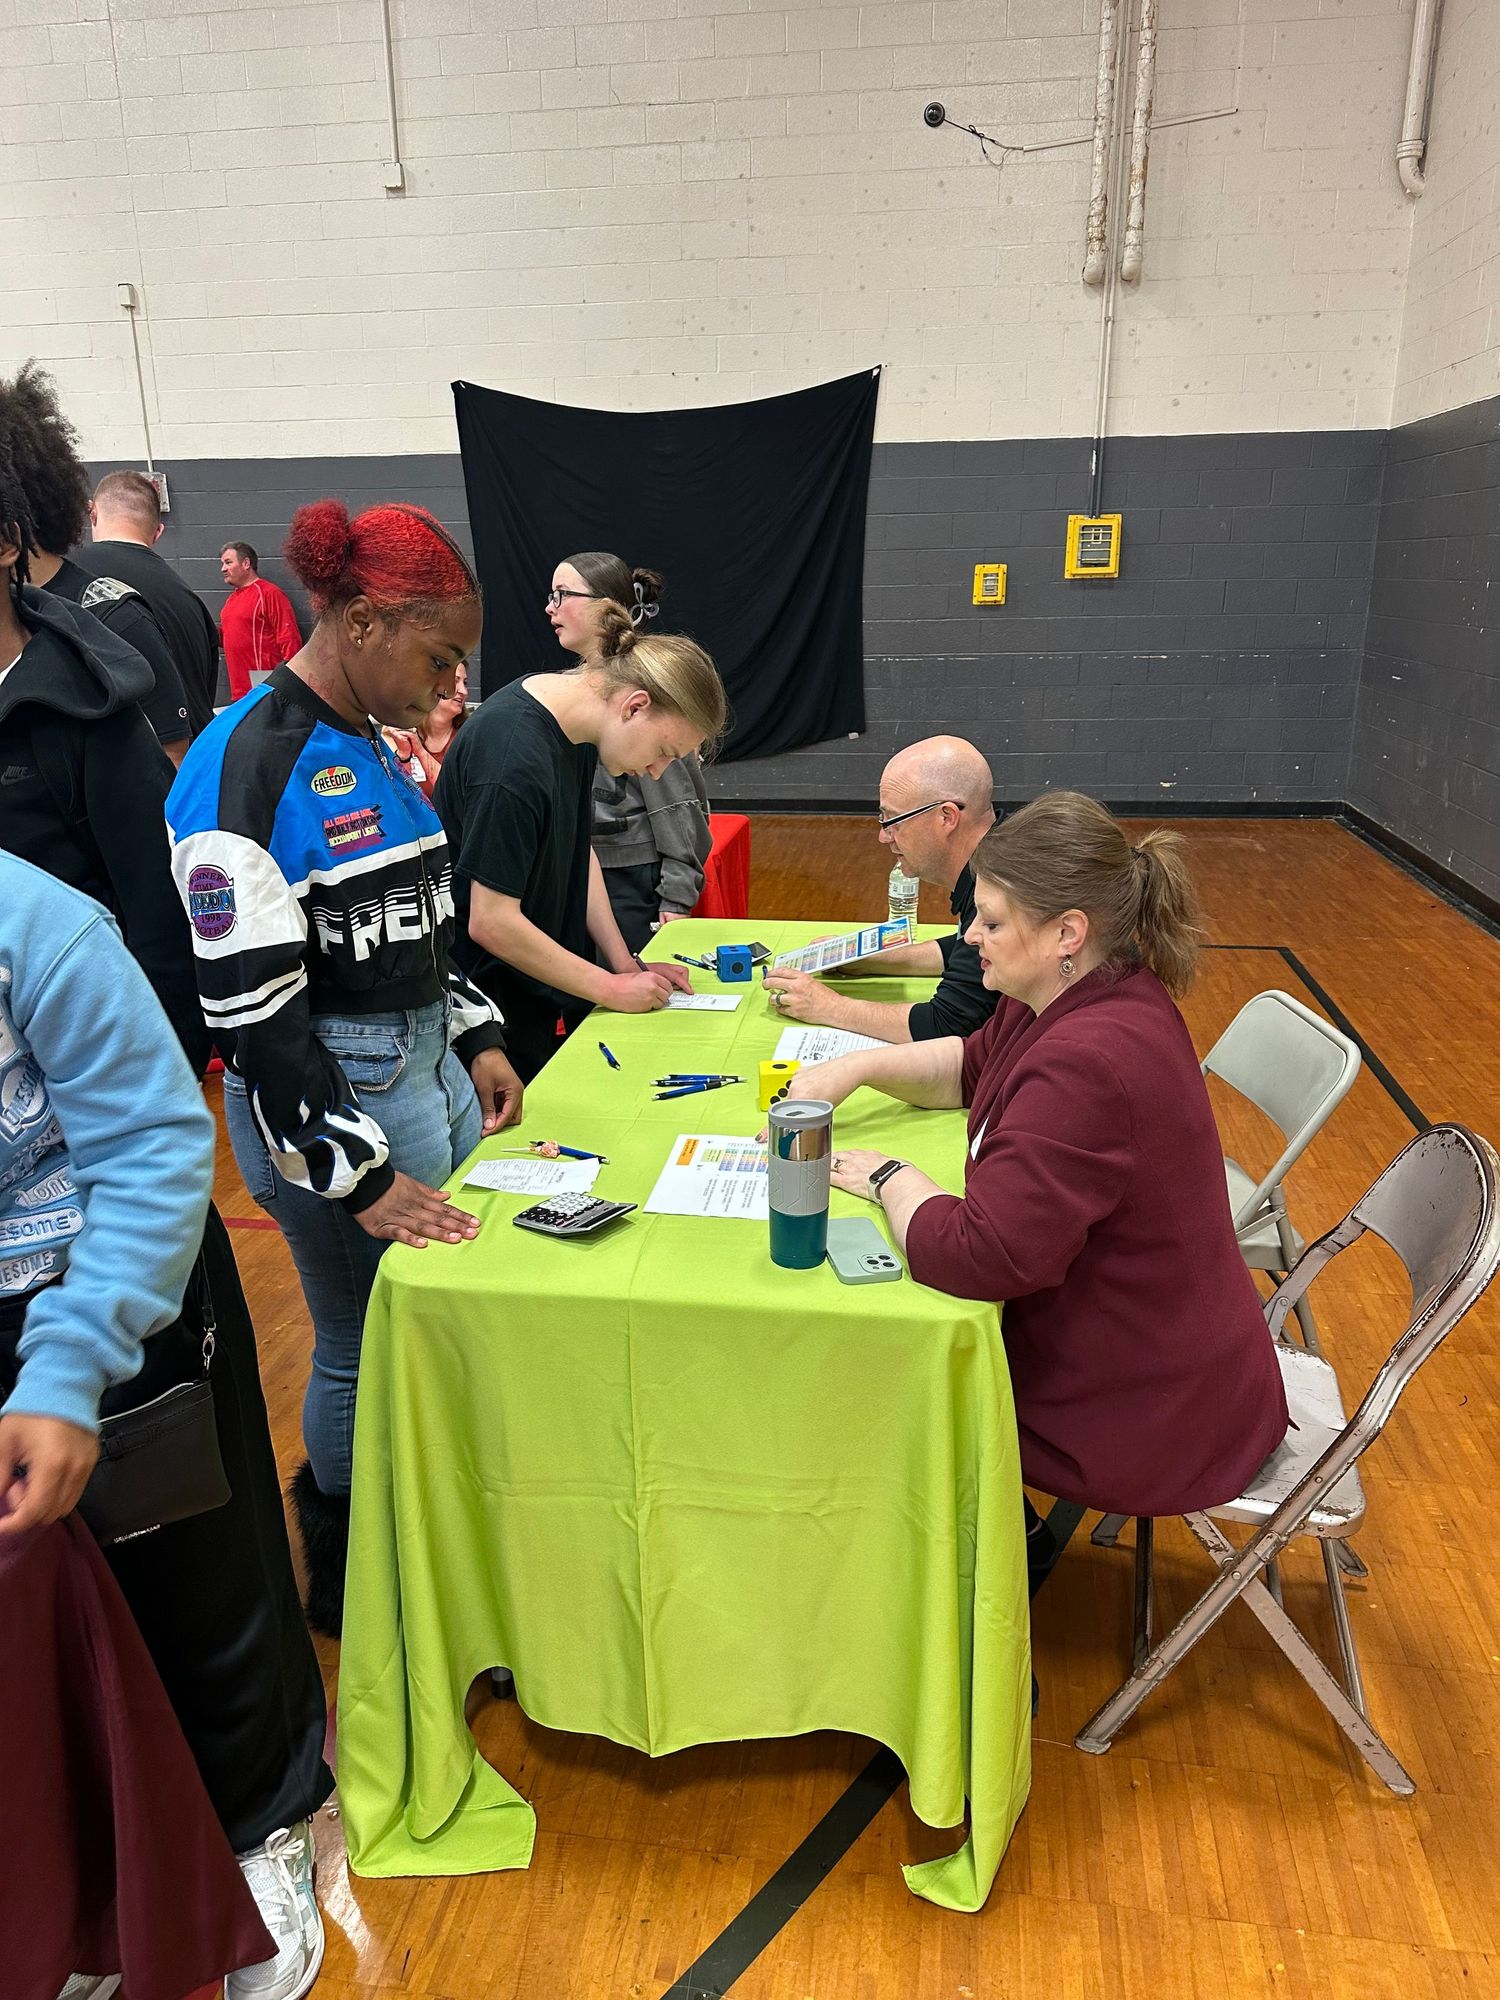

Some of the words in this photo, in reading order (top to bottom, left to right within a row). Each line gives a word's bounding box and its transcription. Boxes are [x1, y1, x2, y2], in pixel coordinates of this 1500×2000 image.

[313, 771, 354, 791] FREEDOM
[202, 914, 222, 924] 1998
[0, 1250, 52, 1285] ESOME
